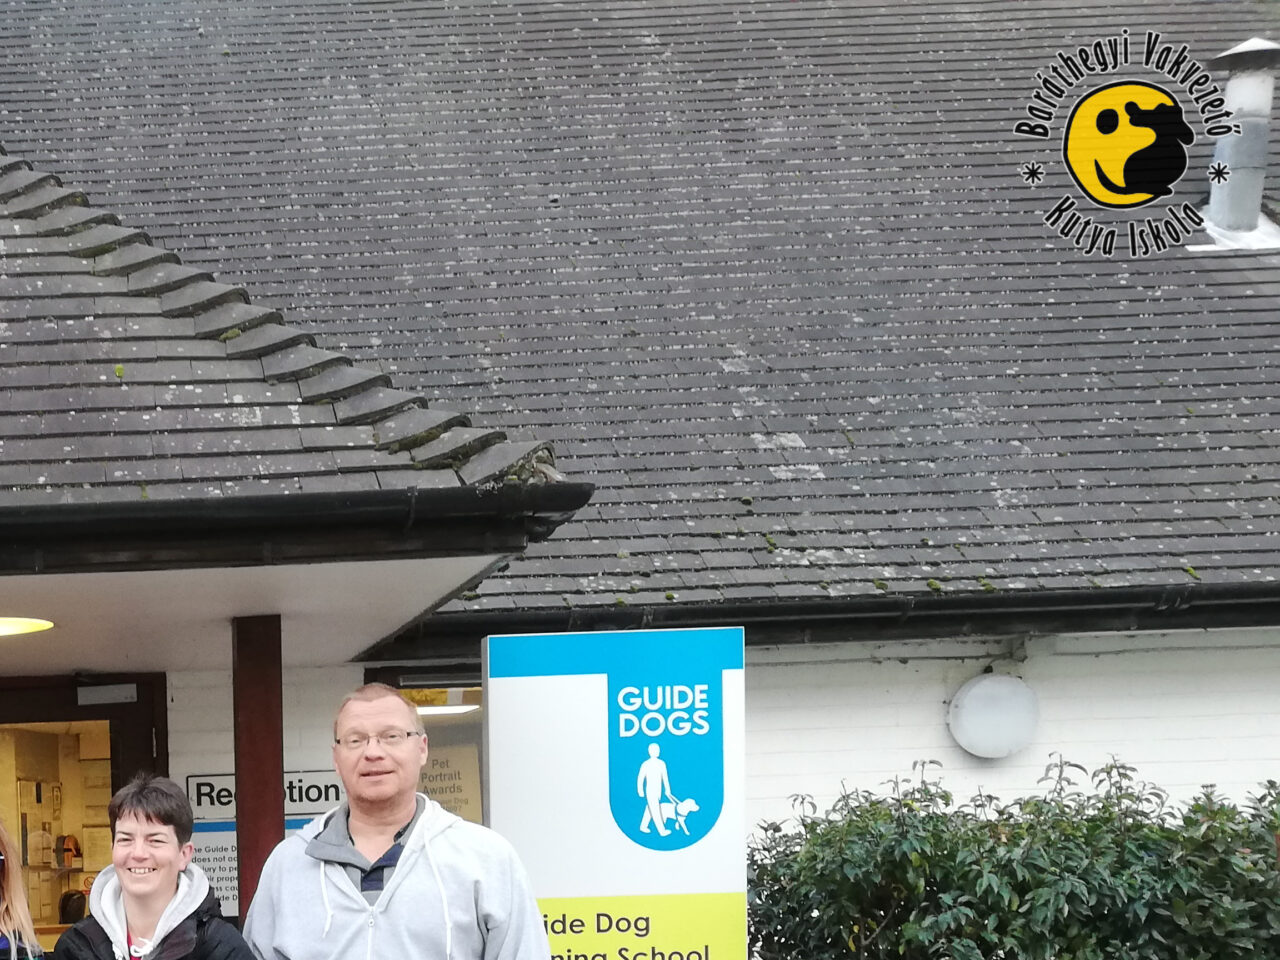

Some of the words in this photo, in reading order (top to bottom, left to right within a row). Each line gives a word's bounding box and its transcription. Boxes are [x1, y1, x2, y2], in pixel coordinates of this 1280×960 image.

[617, 684, 709, 711] GUIDE
[619, 710, 710, 738] DOGS
[432, 759, 449, 769] Pet
[421, 770, 461, 783] Portrait
[196, 779, 340, 806] Retion
[424, 783, 462, 795] Awards
[191, 855, 211, 864] does
[213, 855, 226, 863] not
[543, 913, 586, 935] ide
[596, 912, 651, 937] Dog
